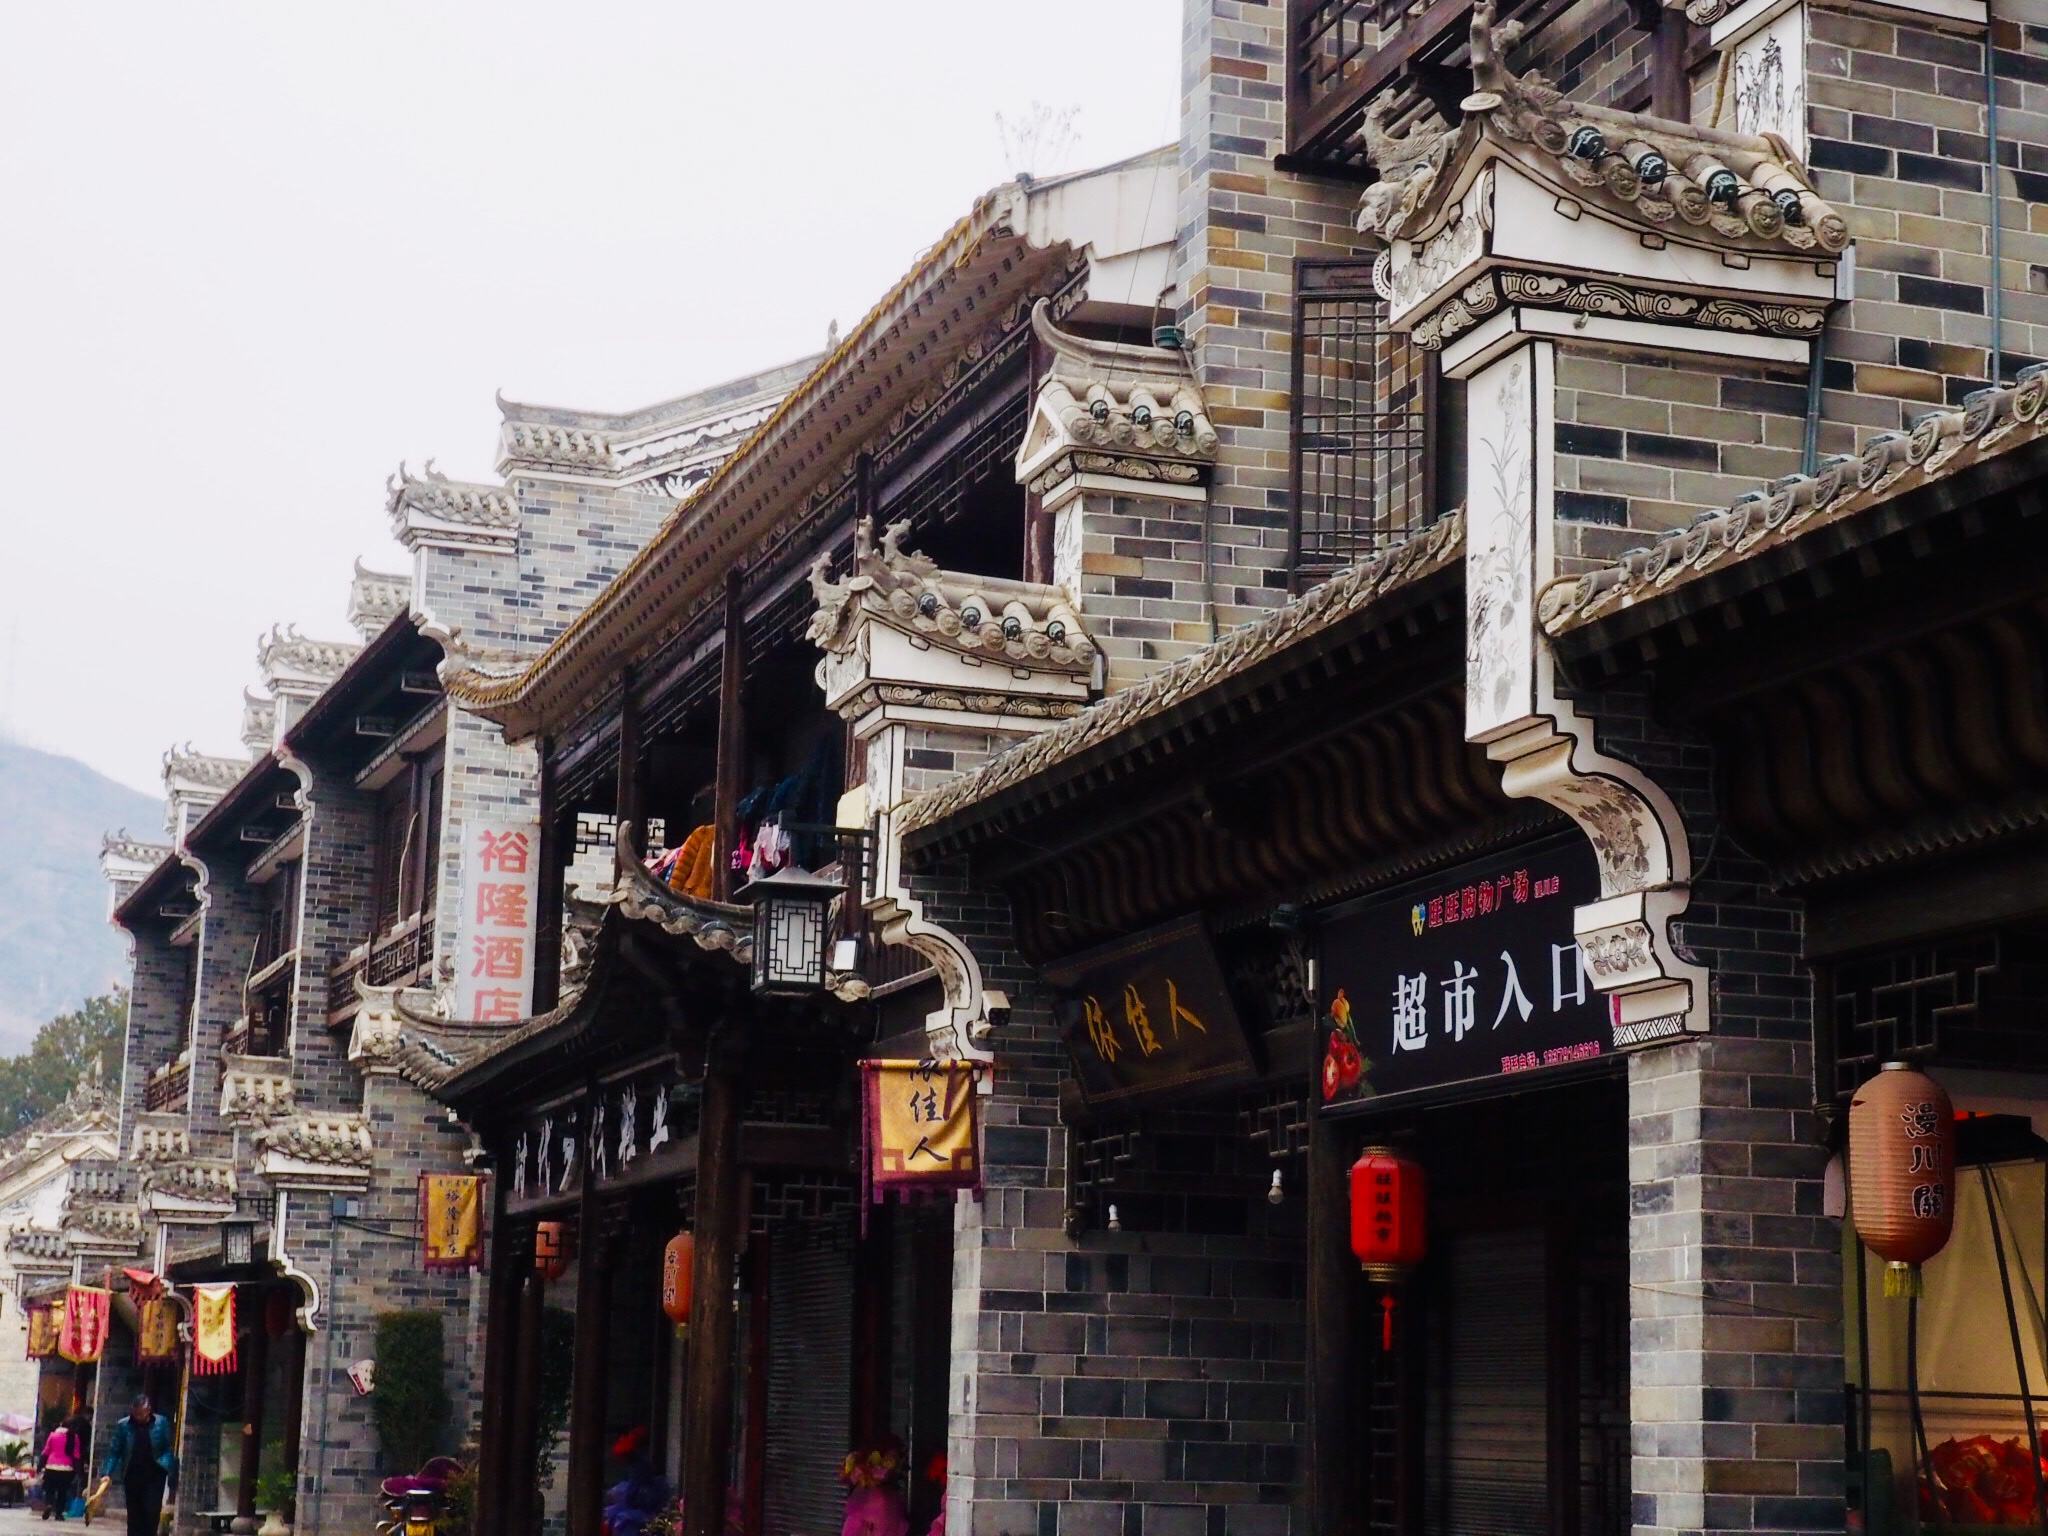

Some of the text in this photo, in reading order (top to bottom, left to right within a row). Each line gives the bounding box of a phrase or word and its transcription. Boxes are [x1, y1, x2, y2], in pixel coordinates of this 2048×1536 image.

[471, 829, 529, 1023] 裕隆酒店
[1428, 869, 1529, 928] 旺旺购物广场
[1392, 943, 1587, 1055] 超市入口
